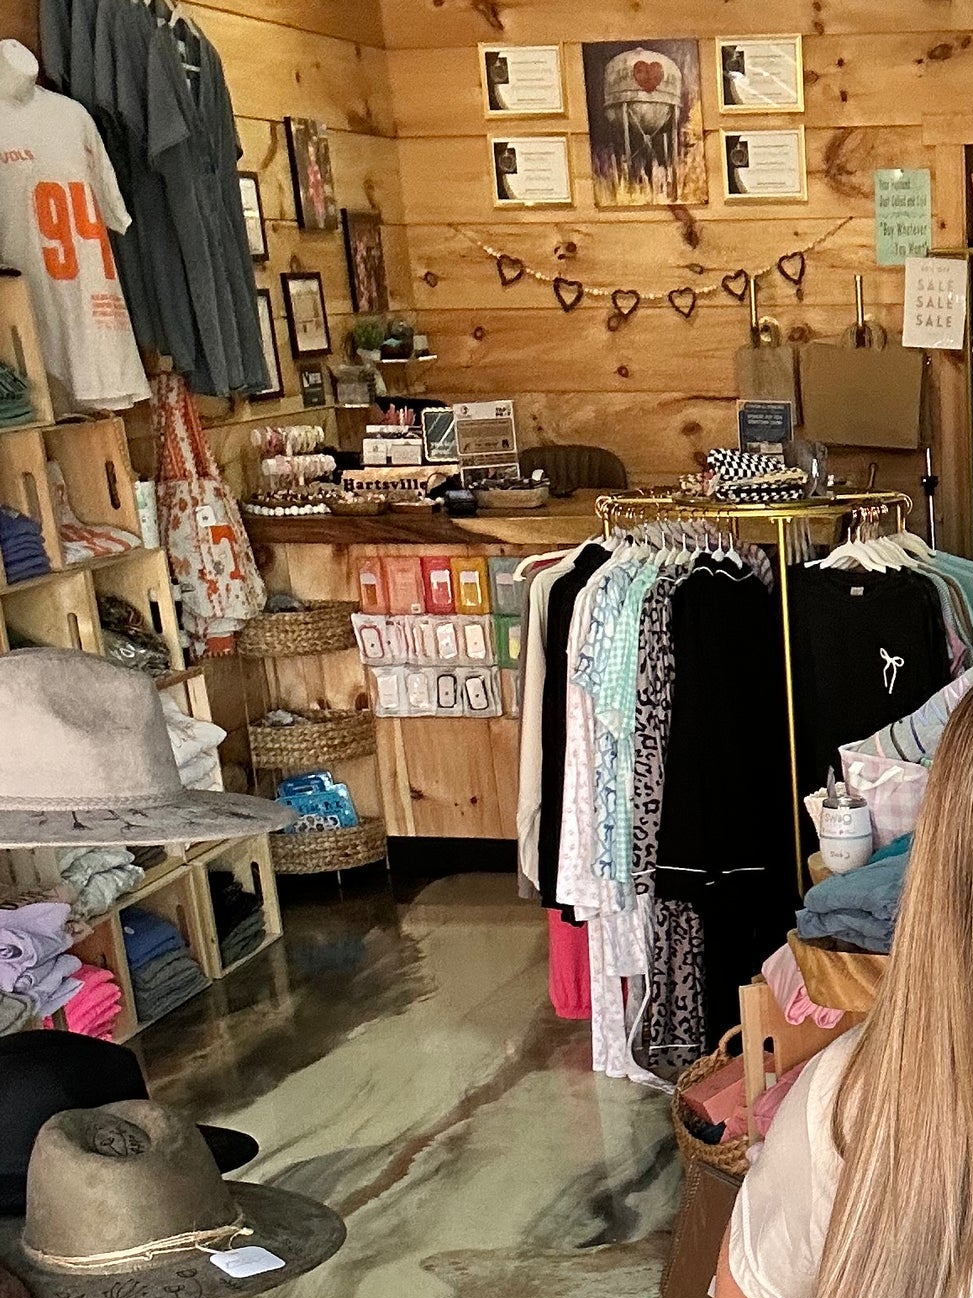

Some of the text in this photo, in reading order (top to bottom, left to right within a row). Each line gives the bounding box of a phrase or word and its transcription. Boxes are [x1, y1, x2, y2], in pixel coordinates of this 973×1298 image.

[34, 181, 115, 280] 94
[917, 279, 954, 292] SALE
[916, 296, 953, 309] SALE
[915, 314, 952, 328] SALE
[343, 477, 427, 493] Hartsville
